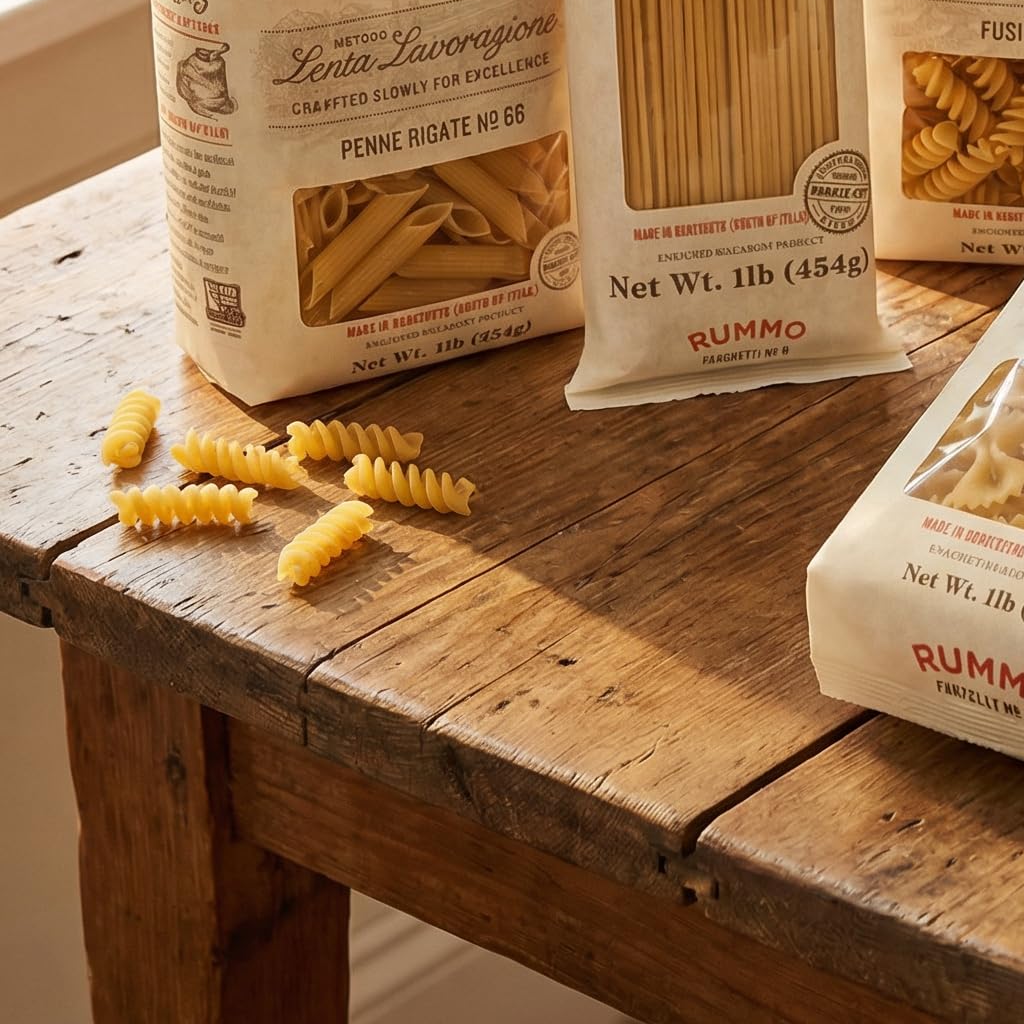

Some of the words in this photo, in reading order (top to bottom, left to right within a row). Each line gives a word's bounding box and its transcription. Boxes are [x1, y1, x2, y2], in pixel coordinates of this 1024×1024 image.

[272, 44, 379, 86] Lenta
[373, 80, 428, 103] SLOWLY
[433, 74, 460, 91] FOR
[465, 51, 550, 84] EXCELLENCE
[341, 130, 403, 161] PENNE
[408, 115, 472, 150] RIGATE
[503, 103, 526, 126] 66
[609, 274, 661, 299] Net
[669, 270, 722, 295] Wt.
[784, 246, 870, 285] (454g)
[687, 319, 807, 352] RUMMO
[902, 561, 940, 590] Net
[946, 574, 978, 603] Wt.
